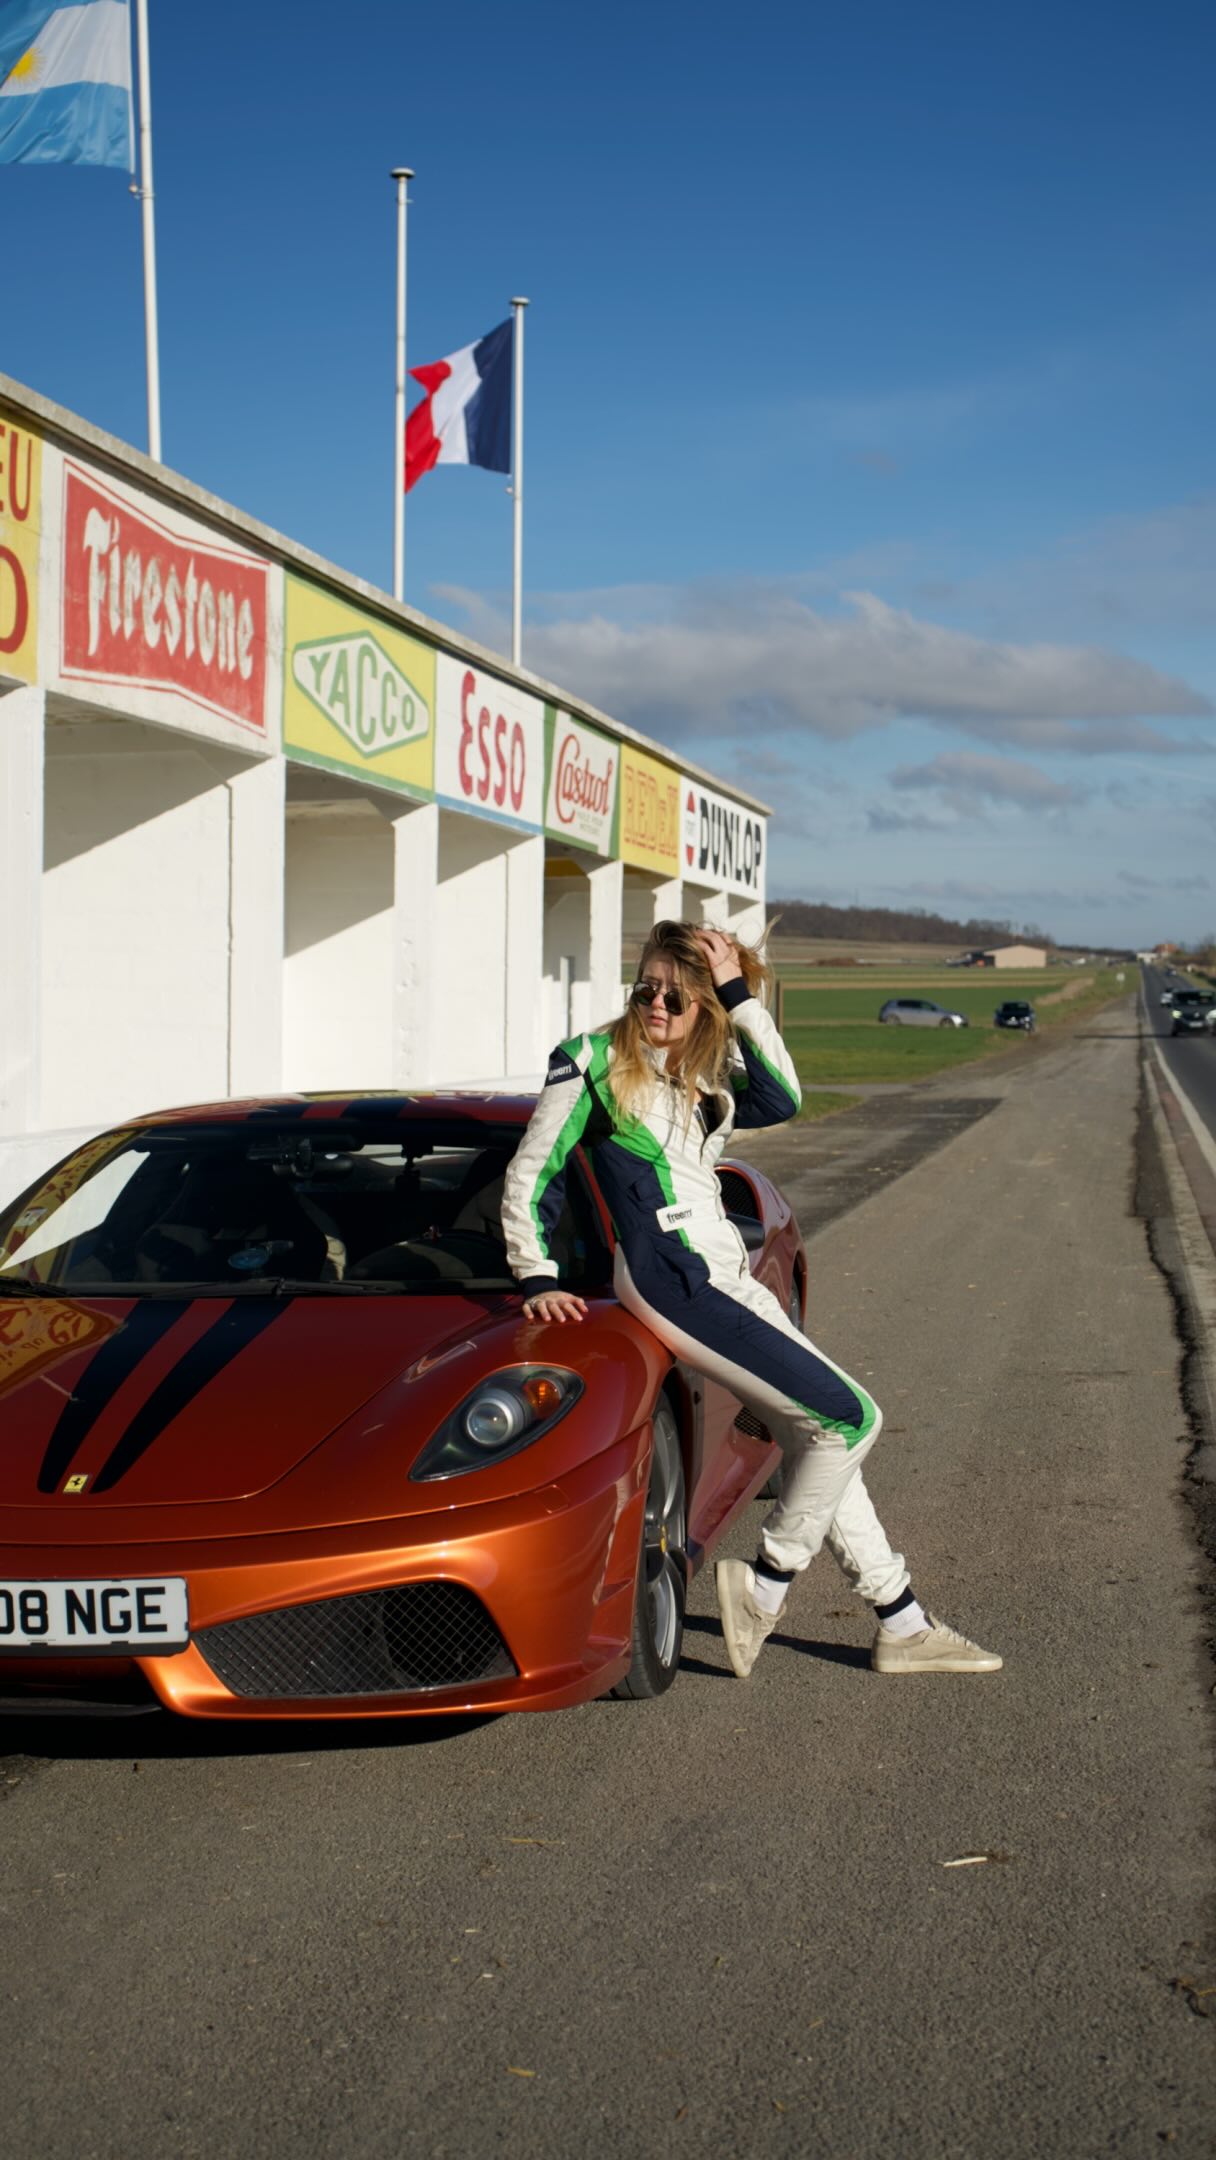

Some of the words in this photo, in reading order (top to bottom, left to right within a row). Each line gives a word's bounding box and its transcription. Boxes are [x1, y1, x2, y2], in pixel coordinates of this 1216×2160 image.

[0, 424, 33, 522] U
[83, 507, 254, 680] Firestone
[556, 733, 614, 824] Castrol
[699, 796, 762, 889] DUNLOP
[65, 1586, 168, 1635] NGE
